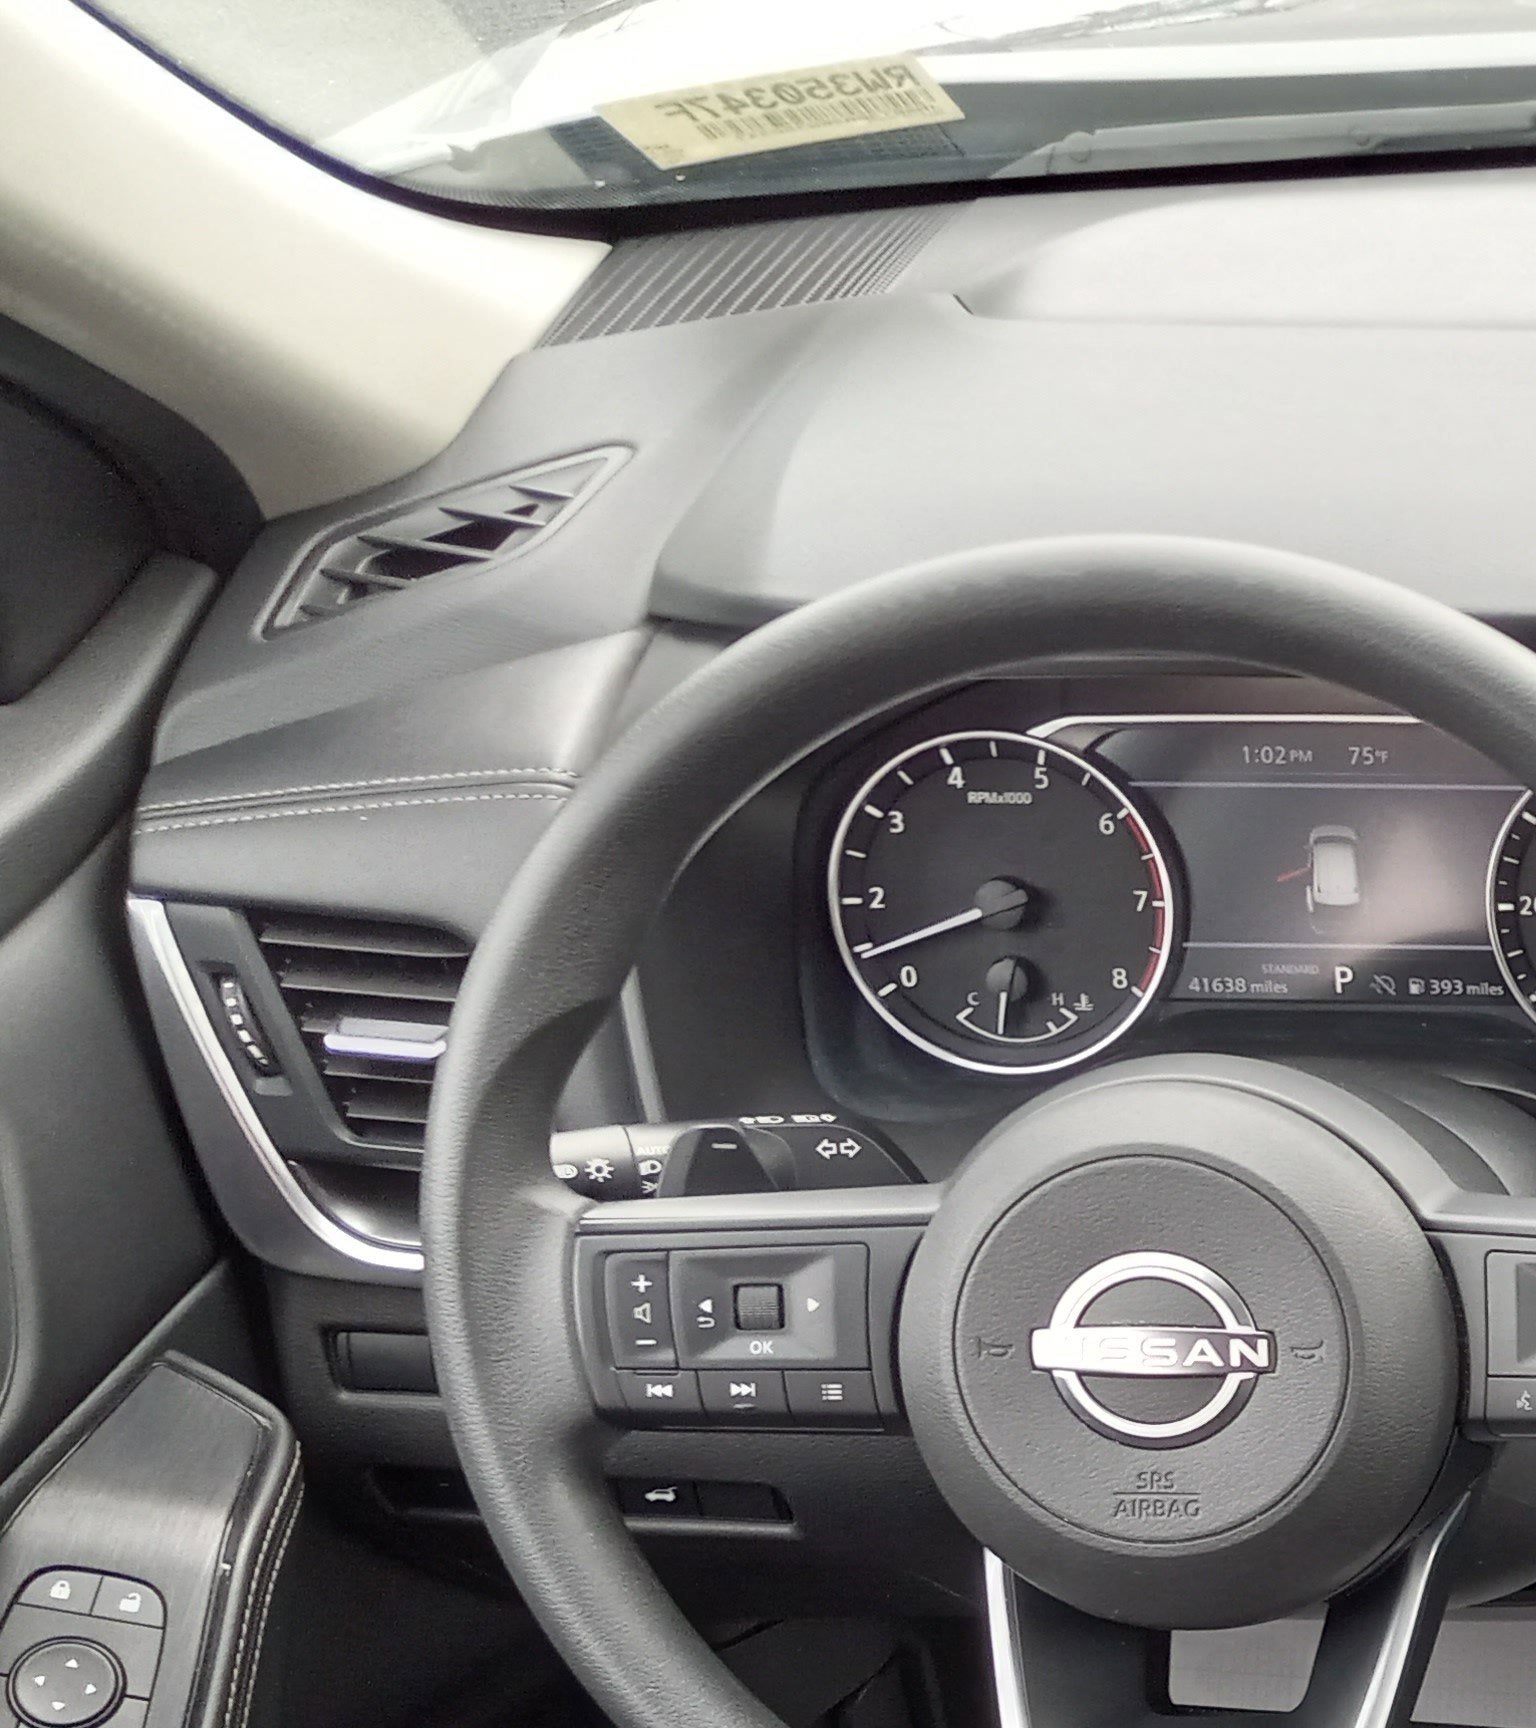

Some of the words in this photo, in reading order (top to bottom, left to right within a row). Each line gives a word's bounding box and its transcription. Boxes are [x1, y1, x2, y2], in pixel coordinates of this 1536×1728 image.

[1242, 744, 1287, 763] 1:02
[1290, 748, 1312, 762] PM
[947, 766, 965, 787] 4
[1034, 766, 1050, 788] 5
[888, 811, 905, 833] 3
[1099, 814, 1115, 835] 6
[869, 888, 885, 909] 2
[1133, 890, 1148, 911] 7
[901, 965, 918, 987] 0
[1112, 968, 1128, 988] 8
[1189, 976, 1247, 993] 41638
[1250, 981, 1288, 994] miles
[1334, 966, 1354, 994] P
[1429, 979, 1463, 995] 393
[1466, 983, 1504, 996] miles
[749, 1341, 774, 1354] OK
[1136, 1472, 1175, 1491] SRS
[1114, 1500, 1201, 1518] AIRBAG
